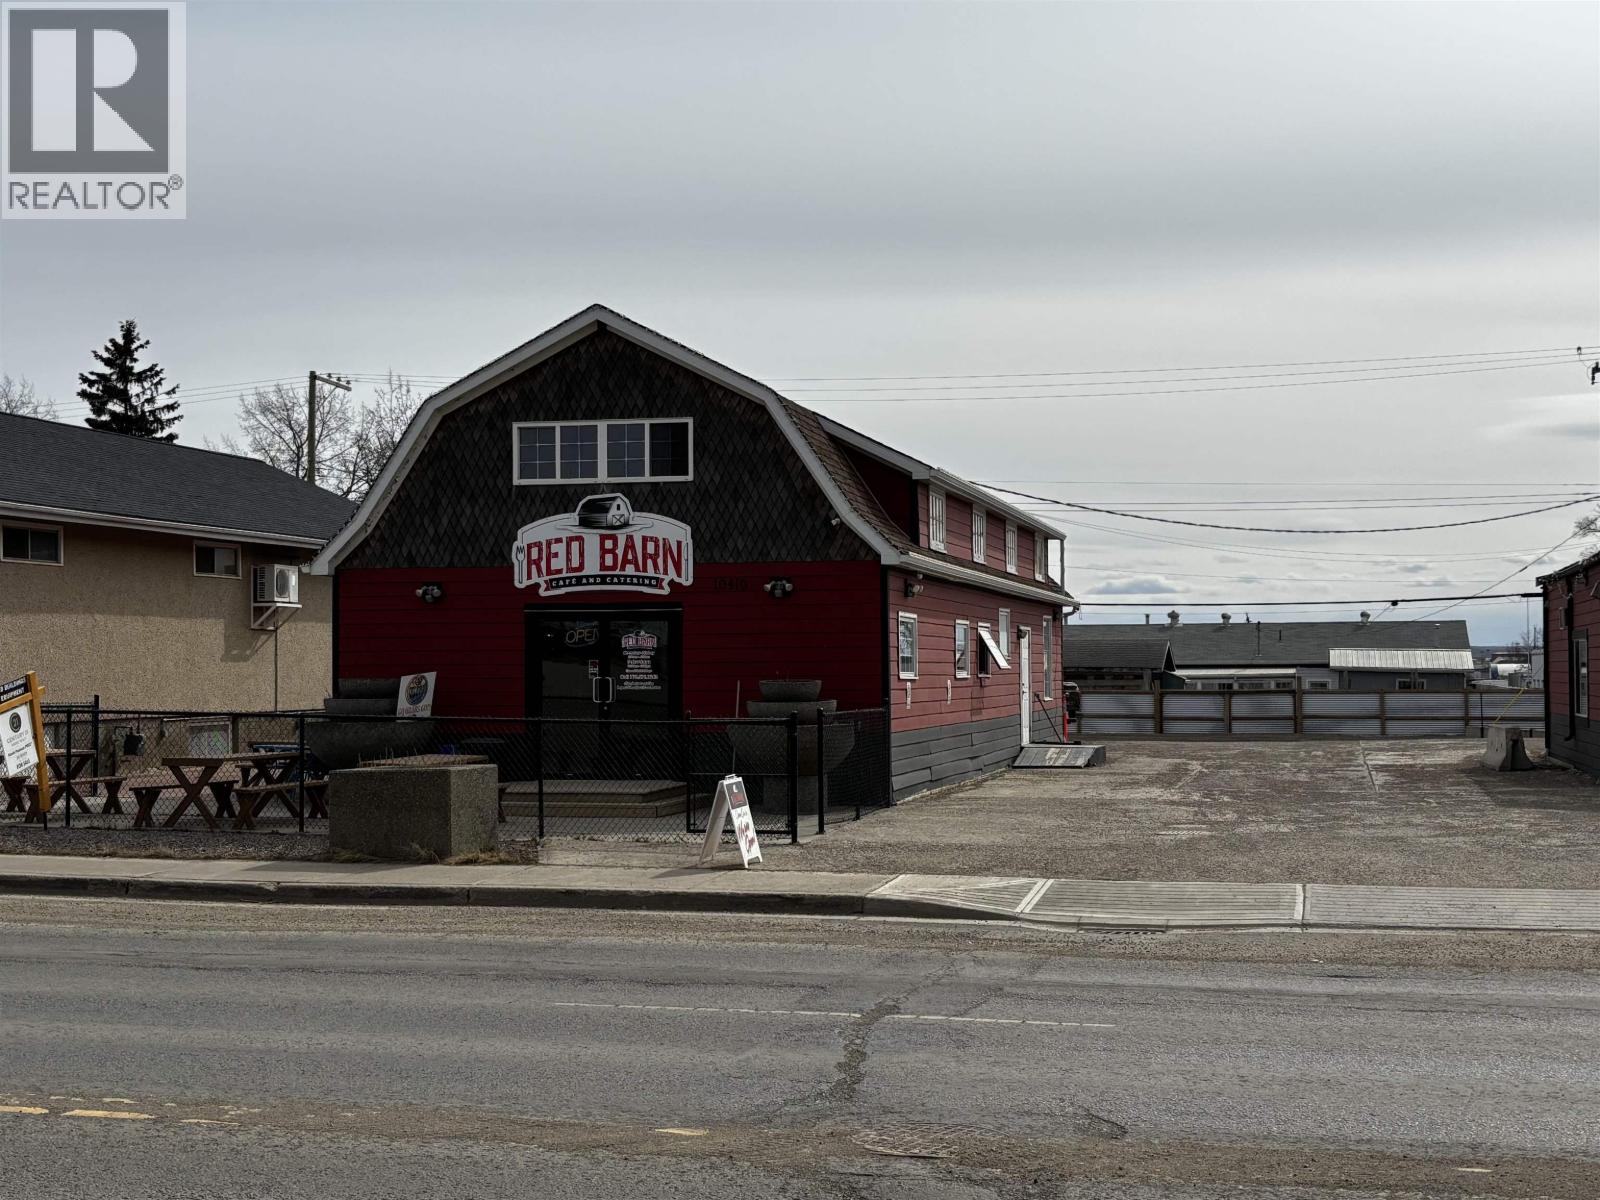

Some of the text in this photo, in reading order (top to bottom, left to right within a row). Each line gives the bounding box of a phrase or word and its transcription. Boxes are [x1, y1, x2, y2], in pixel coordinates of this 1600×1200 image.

[526, 533, 683, 581] RED BARN
[606, 577, 657, 585] CATERING
